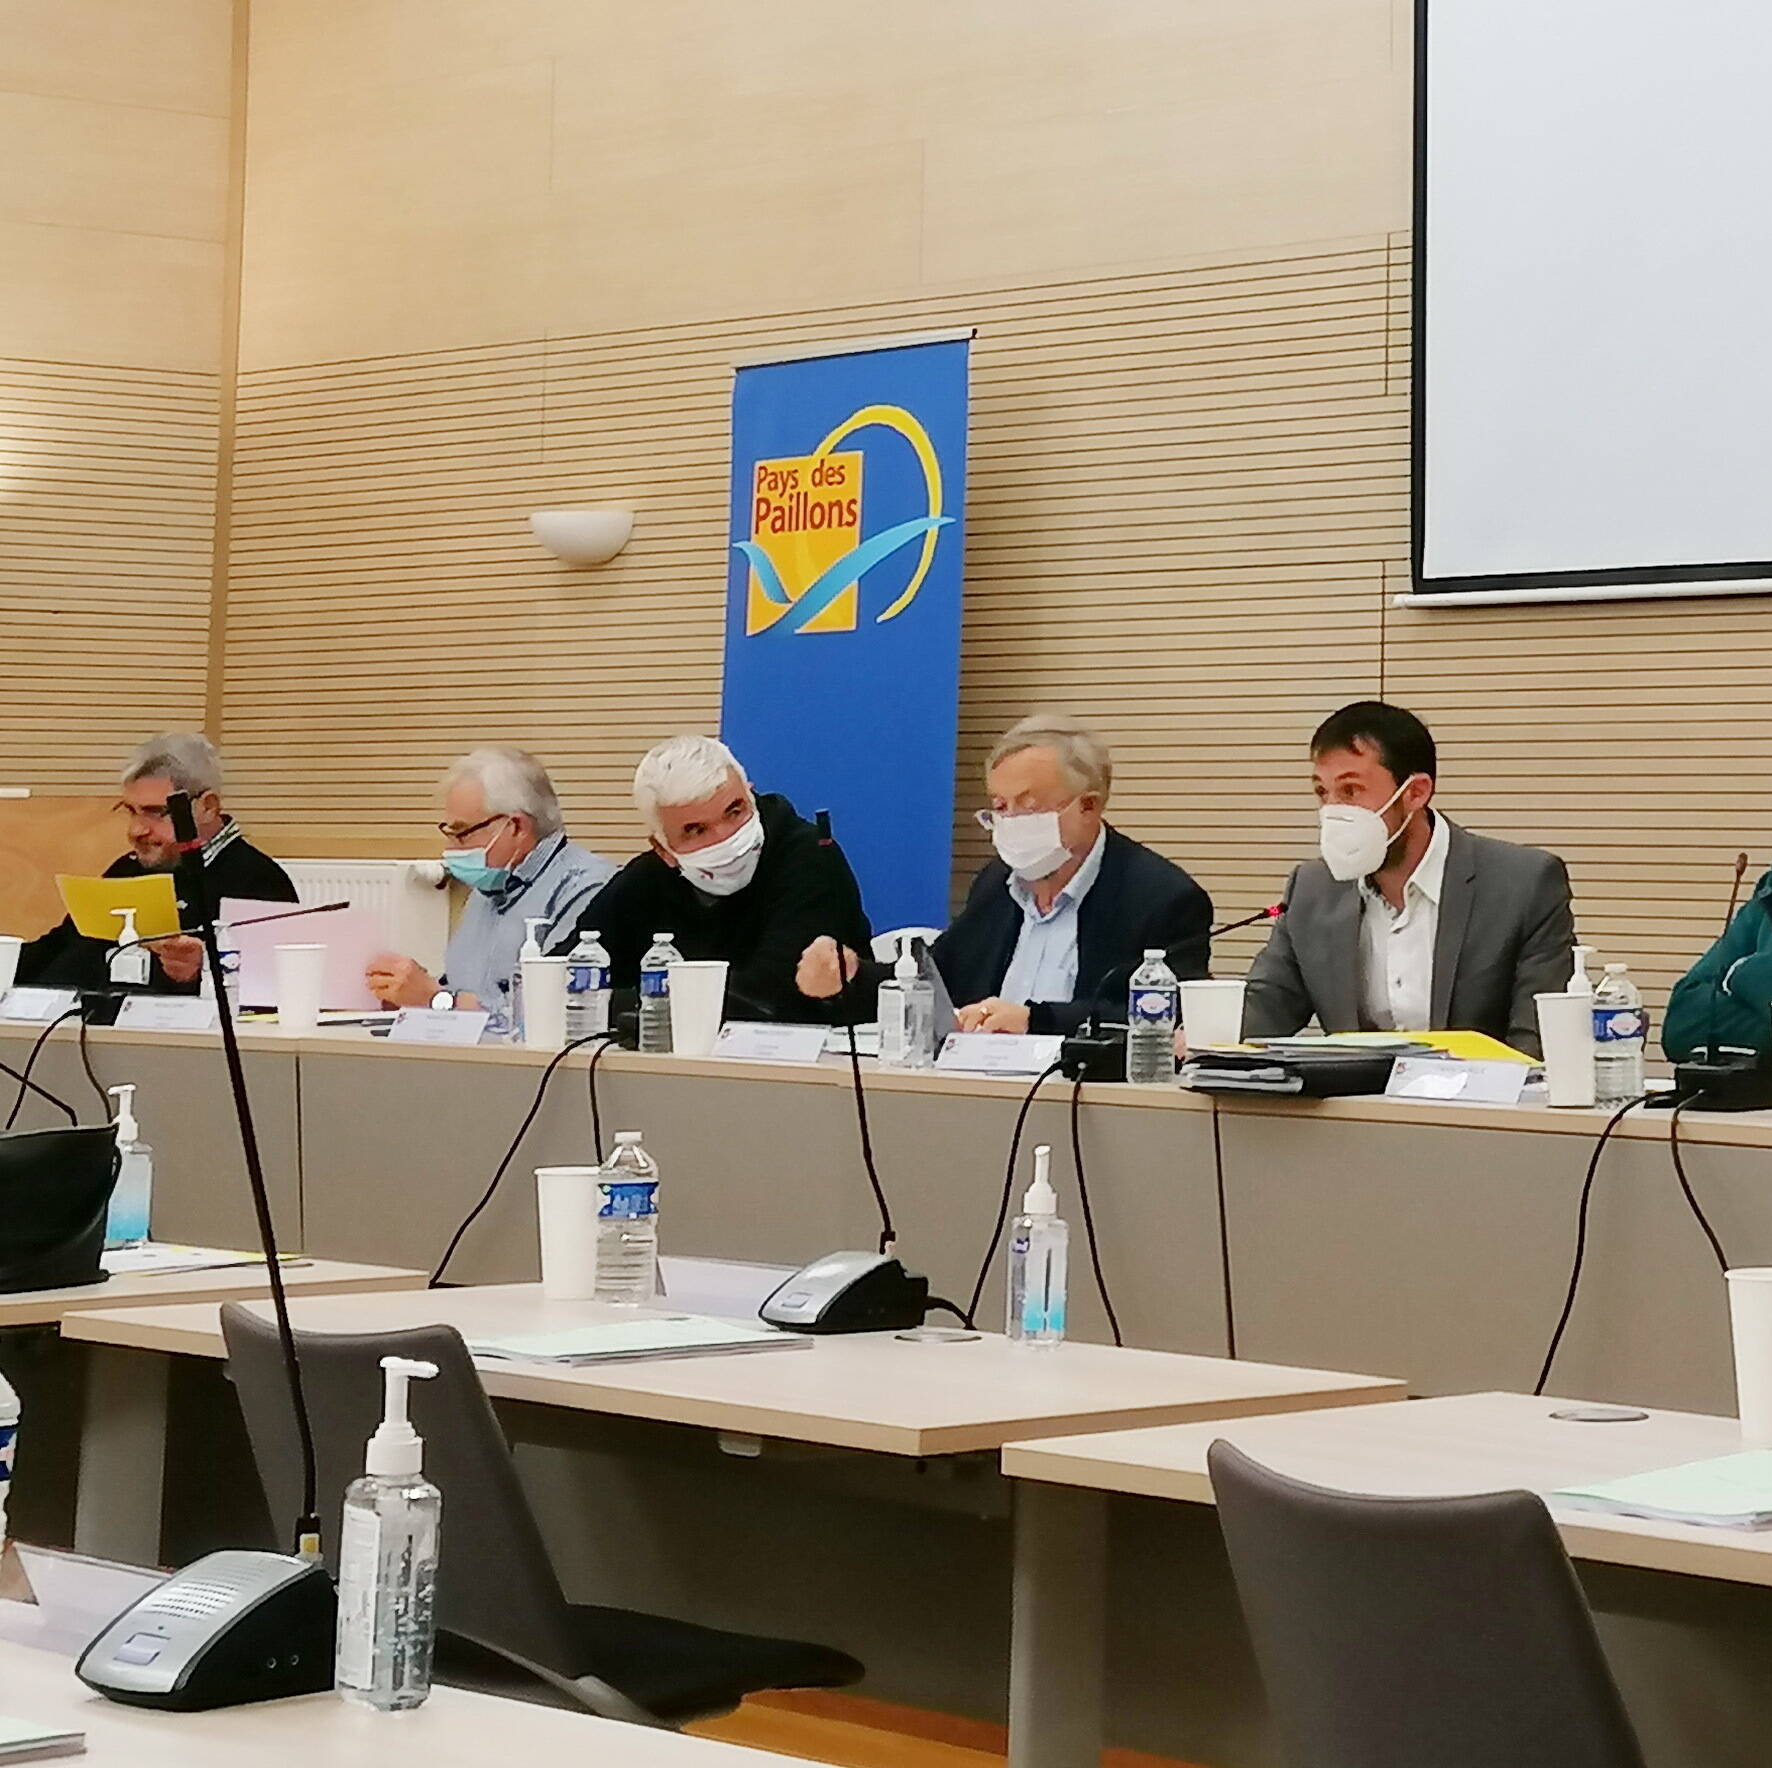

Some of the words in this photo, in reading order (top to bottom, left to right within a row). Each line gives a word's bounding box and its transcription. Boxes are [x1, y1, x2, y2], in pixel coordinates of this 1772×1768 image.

[757, 466, 799, 498] Pays
[811, 459, 845, 488] des
[755, 491, 858, 535] Paillons
